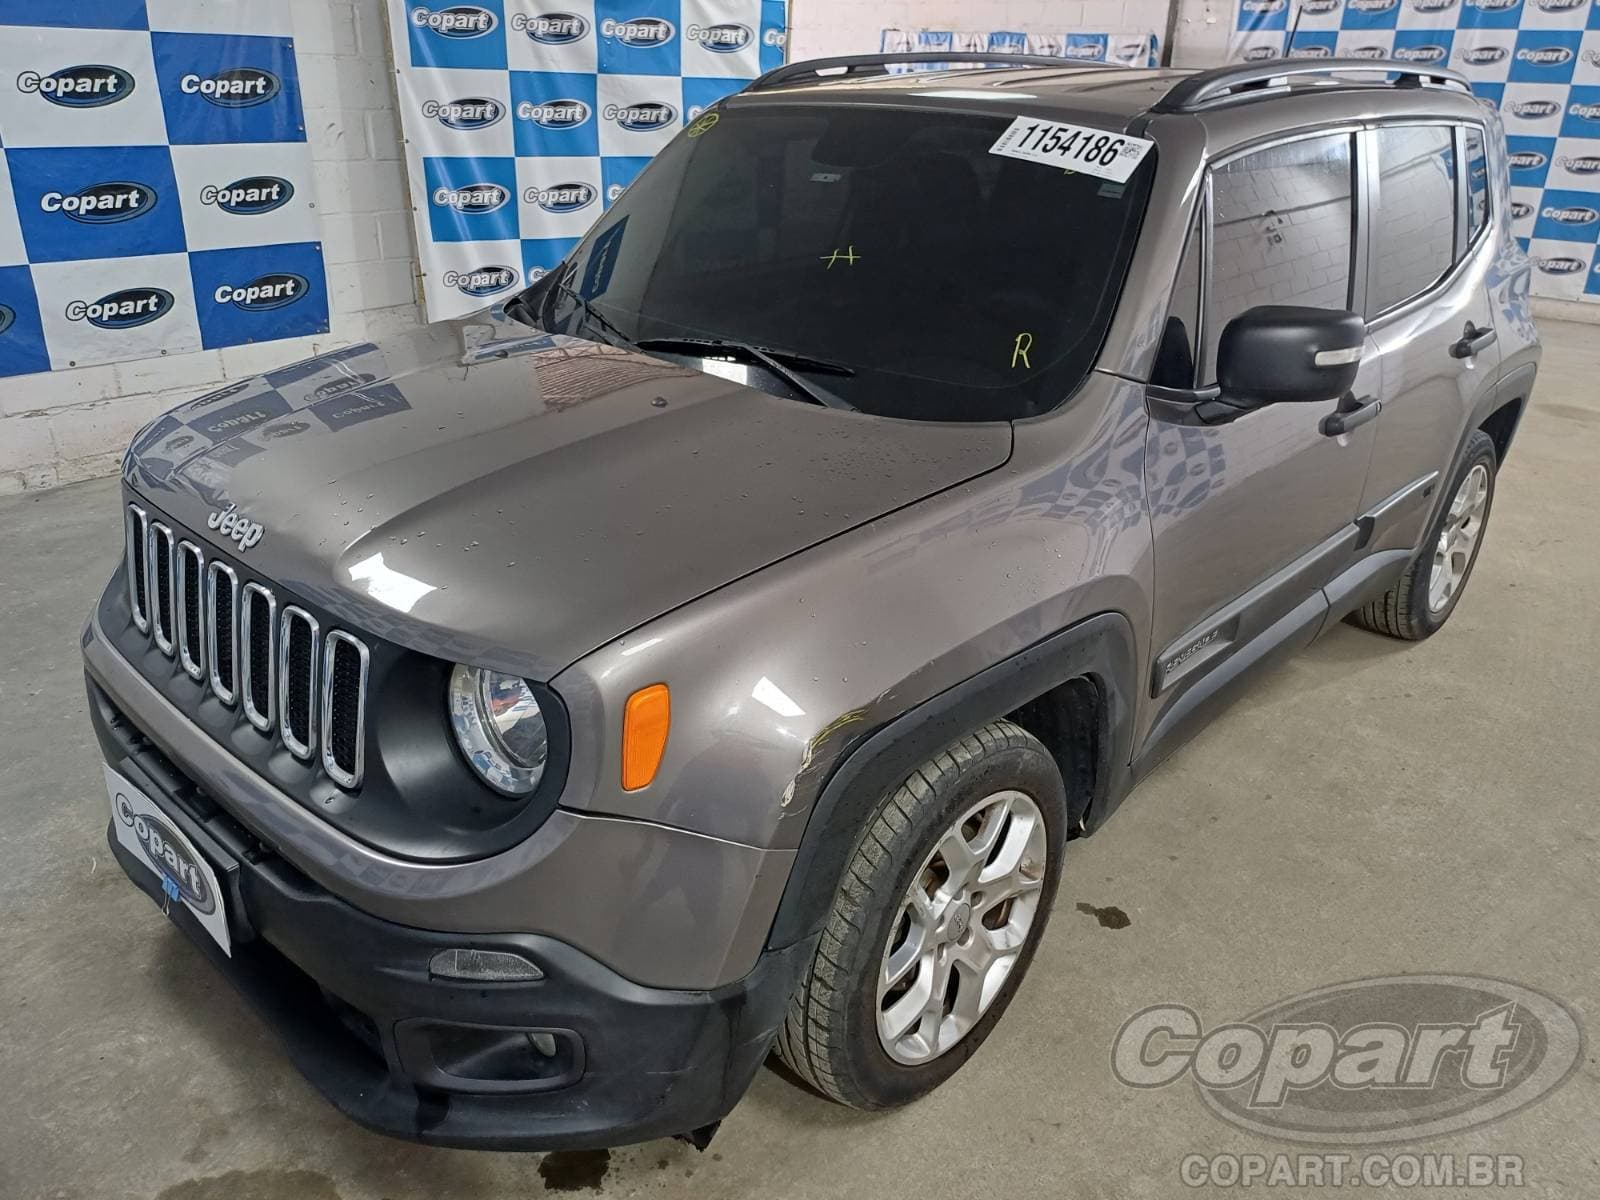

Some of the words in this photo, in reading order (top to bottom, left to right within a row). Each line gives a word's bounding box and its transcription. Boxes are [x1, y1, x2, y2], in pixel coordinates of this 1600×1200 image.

[412, 8, 489, 31] Copart
[511, 14, 581, 37] Copart
[601, 19, 666, 41] Copart
[686, 23, 745, 44] Copart
[1517, 49, 1569, 63] Copart
[17, 71, 118, 97] Copart
[181, 73, 266, 95] Copart
[423, 101, 494, 124] Copart
[517, 102, 582, 124] Copart
[603, 104, 667, 124] Copart
[1504, 101, 1553, 115] Copart
[1569, 104, 1600, 119] Copa
[1018, 124, 1125, 166] 1154186
[1508, 155, 1542, 168] part
[1555, 156, 1600, 172] Copar
[41, 189, 139, 215] Copart
[200, 183, 280, 206] Copart
[433, 187, 501, 208] Copart
[524, 185, 588, 206] Copart
[1542, 207, 1594, 222] Copart
[214, 278, 295, 305] Copart
[443, 269, 508, 292] Copart
[66, 294, 158, 321] Copart
[1011, 332, 1033, 369] R
[207, 502, 265, 552] Jeep
[115, 792, 203, 900] Copart
